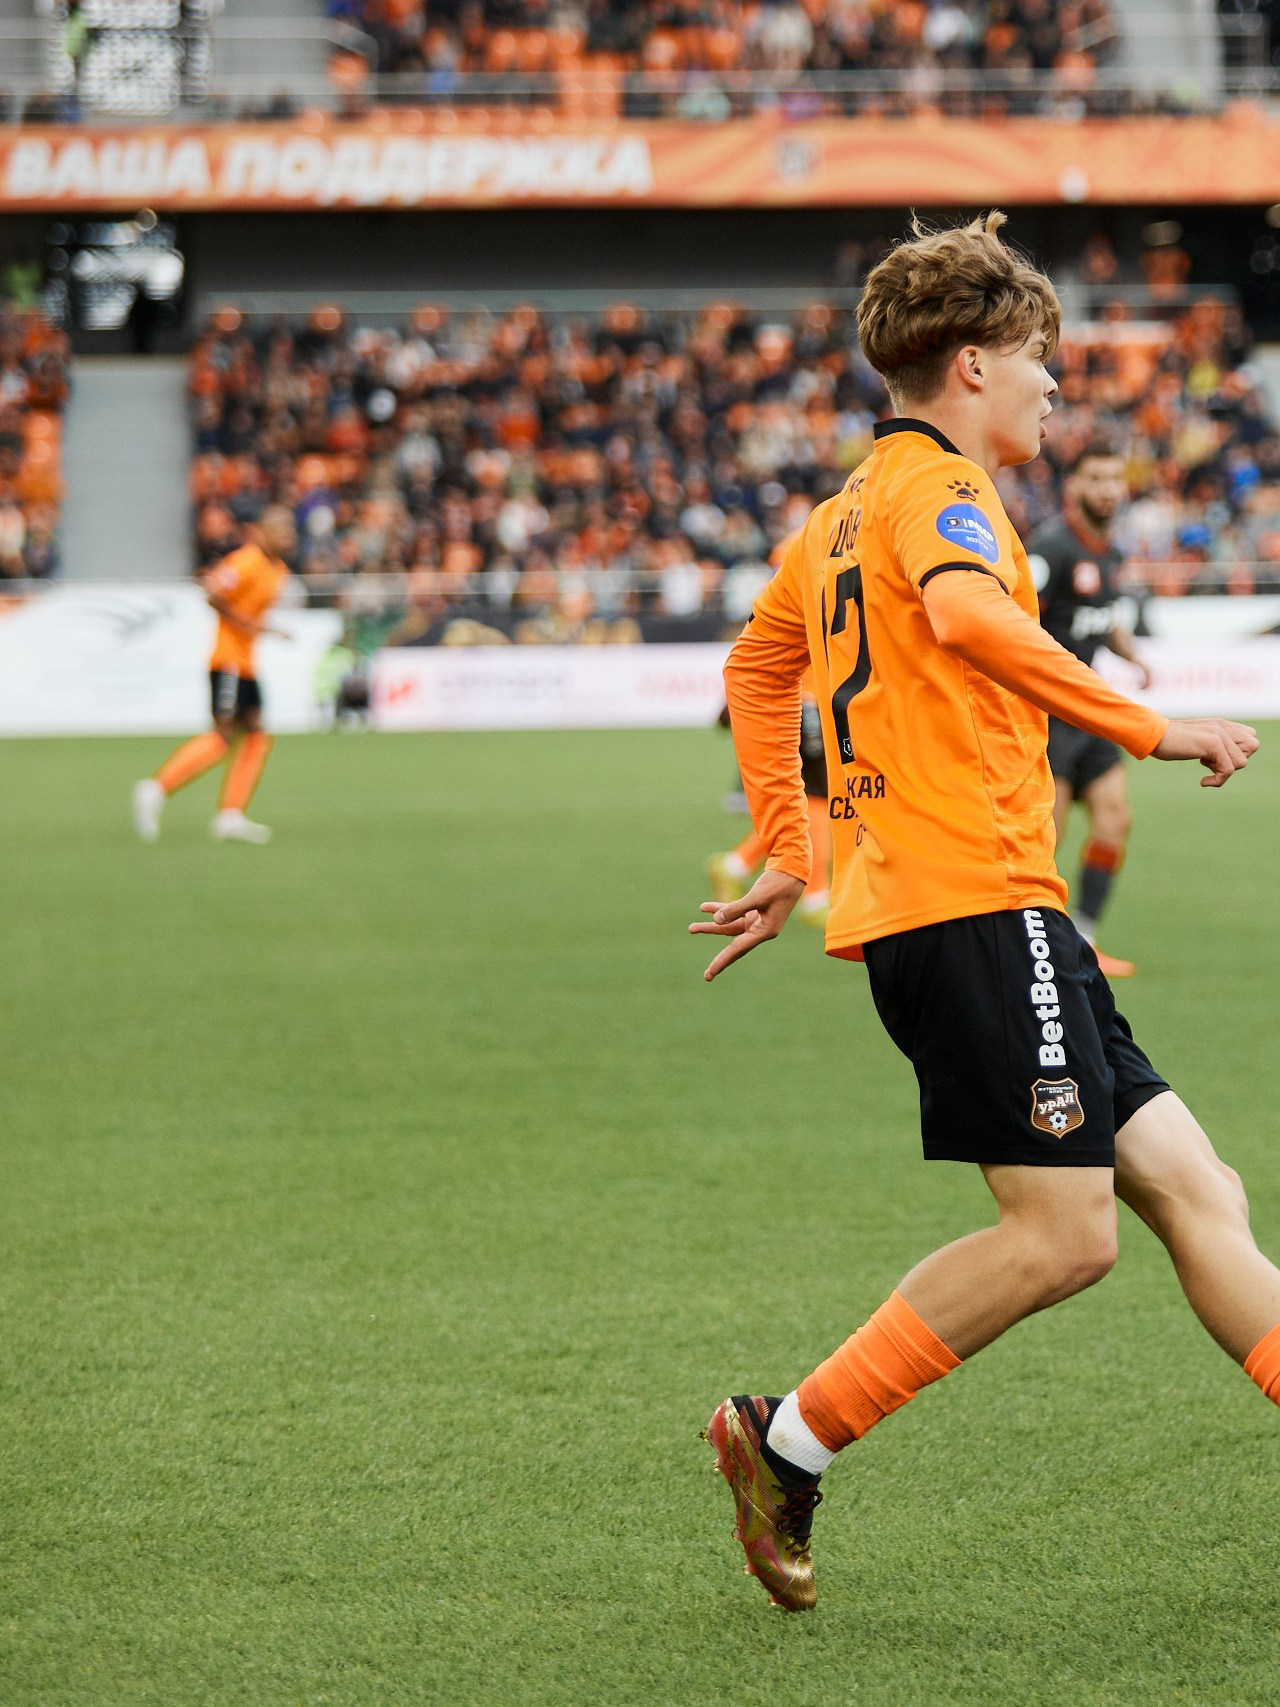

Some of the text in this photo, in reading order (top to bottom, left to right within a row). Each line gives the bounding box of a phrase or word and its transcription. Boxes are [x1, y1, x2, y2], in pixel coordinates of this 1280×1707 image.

[5, 134, 654, 206] ВАША ПОДДЕРЖКА
[1023, 909, 1067, 1067] BetBoom
[1037, 1092, 1075, 1115] УРАЛ
